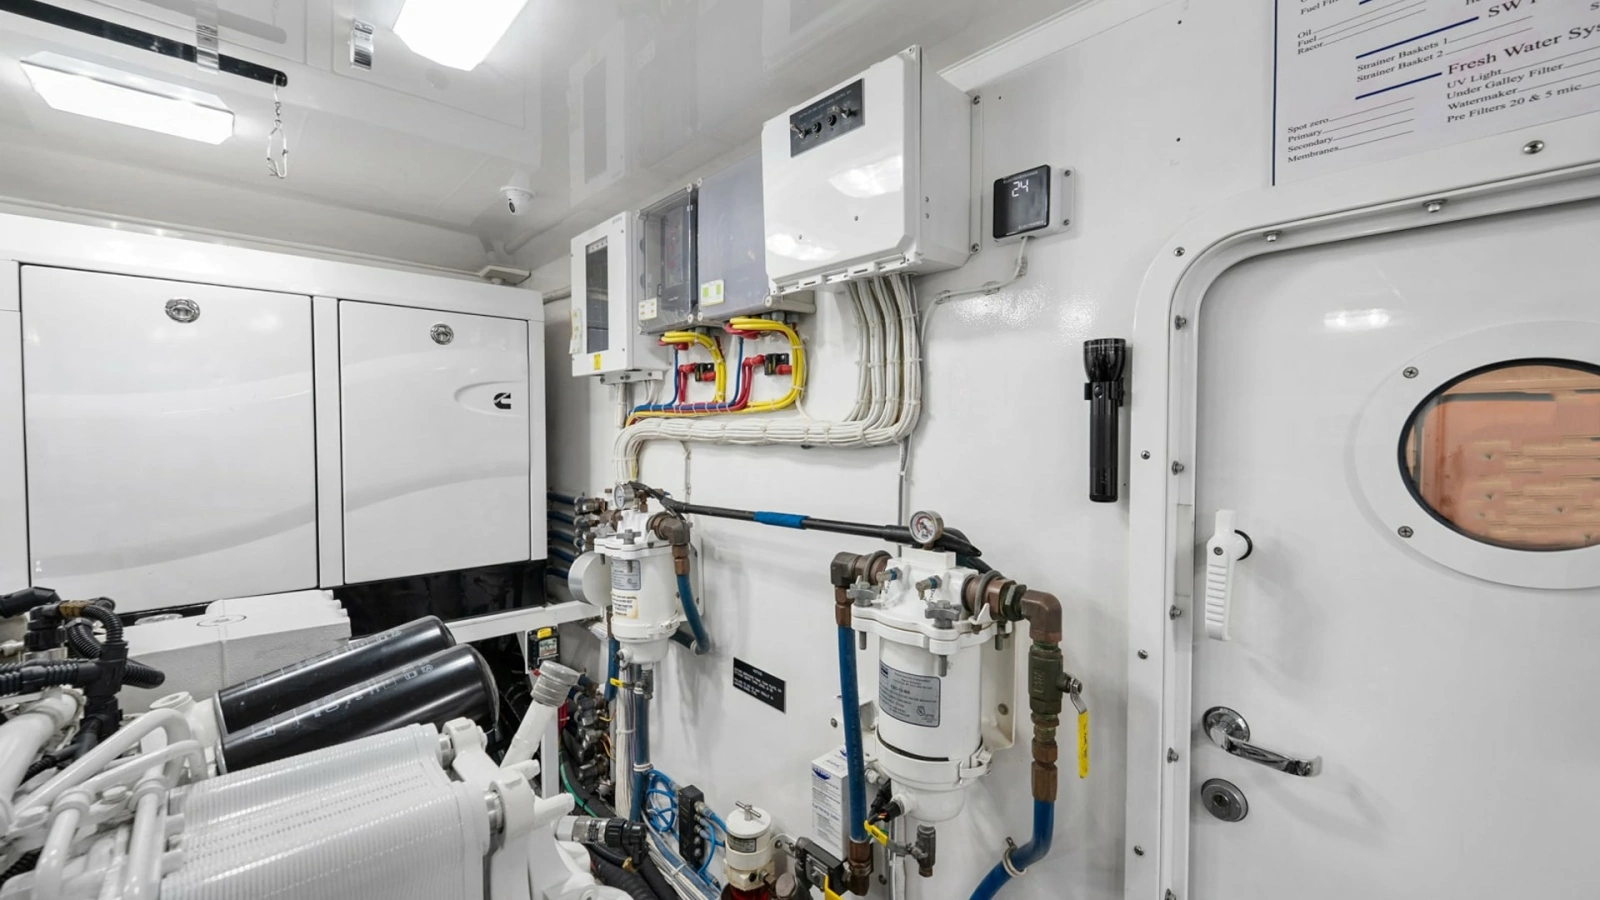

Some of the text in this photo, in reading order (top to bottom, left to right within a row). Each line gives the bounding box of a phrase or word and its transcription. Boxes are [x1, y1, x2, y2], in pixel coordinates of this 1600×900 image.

[1300, 2, 1320, 15] Fuel
[1297, 29, 1311, 39] Oil
[1298, 35, 1317, 47] Fuel
[1297, 42, 1324, 55] Racor
[1357, 55, 1395, 72] Strainer
[1398, 42, 1439, 59] Baskets
[1448, 53, 1497, 75] Fresh
[1504, 35, 1562, 57] Water
[1356, 50, 1443, 83] Strainer Basket 2
[1446, 68, 1502, 89] UV Light
[1447, 63, 1564, 100] Under Galley Filter
[1447, 84, 1582, 123] Pre Filters 20 & 5 mic
[1448, 87, 1518, 110] Watermaker
[1287, 118, 1329, 133] Spot zero
[1287, 136, 1333, 153] Secondary
[1288, 129, 1322, 143] Primary
[1287, 146, 1339, 163] Membranes
[1011, 179, 1029, 198] 24
